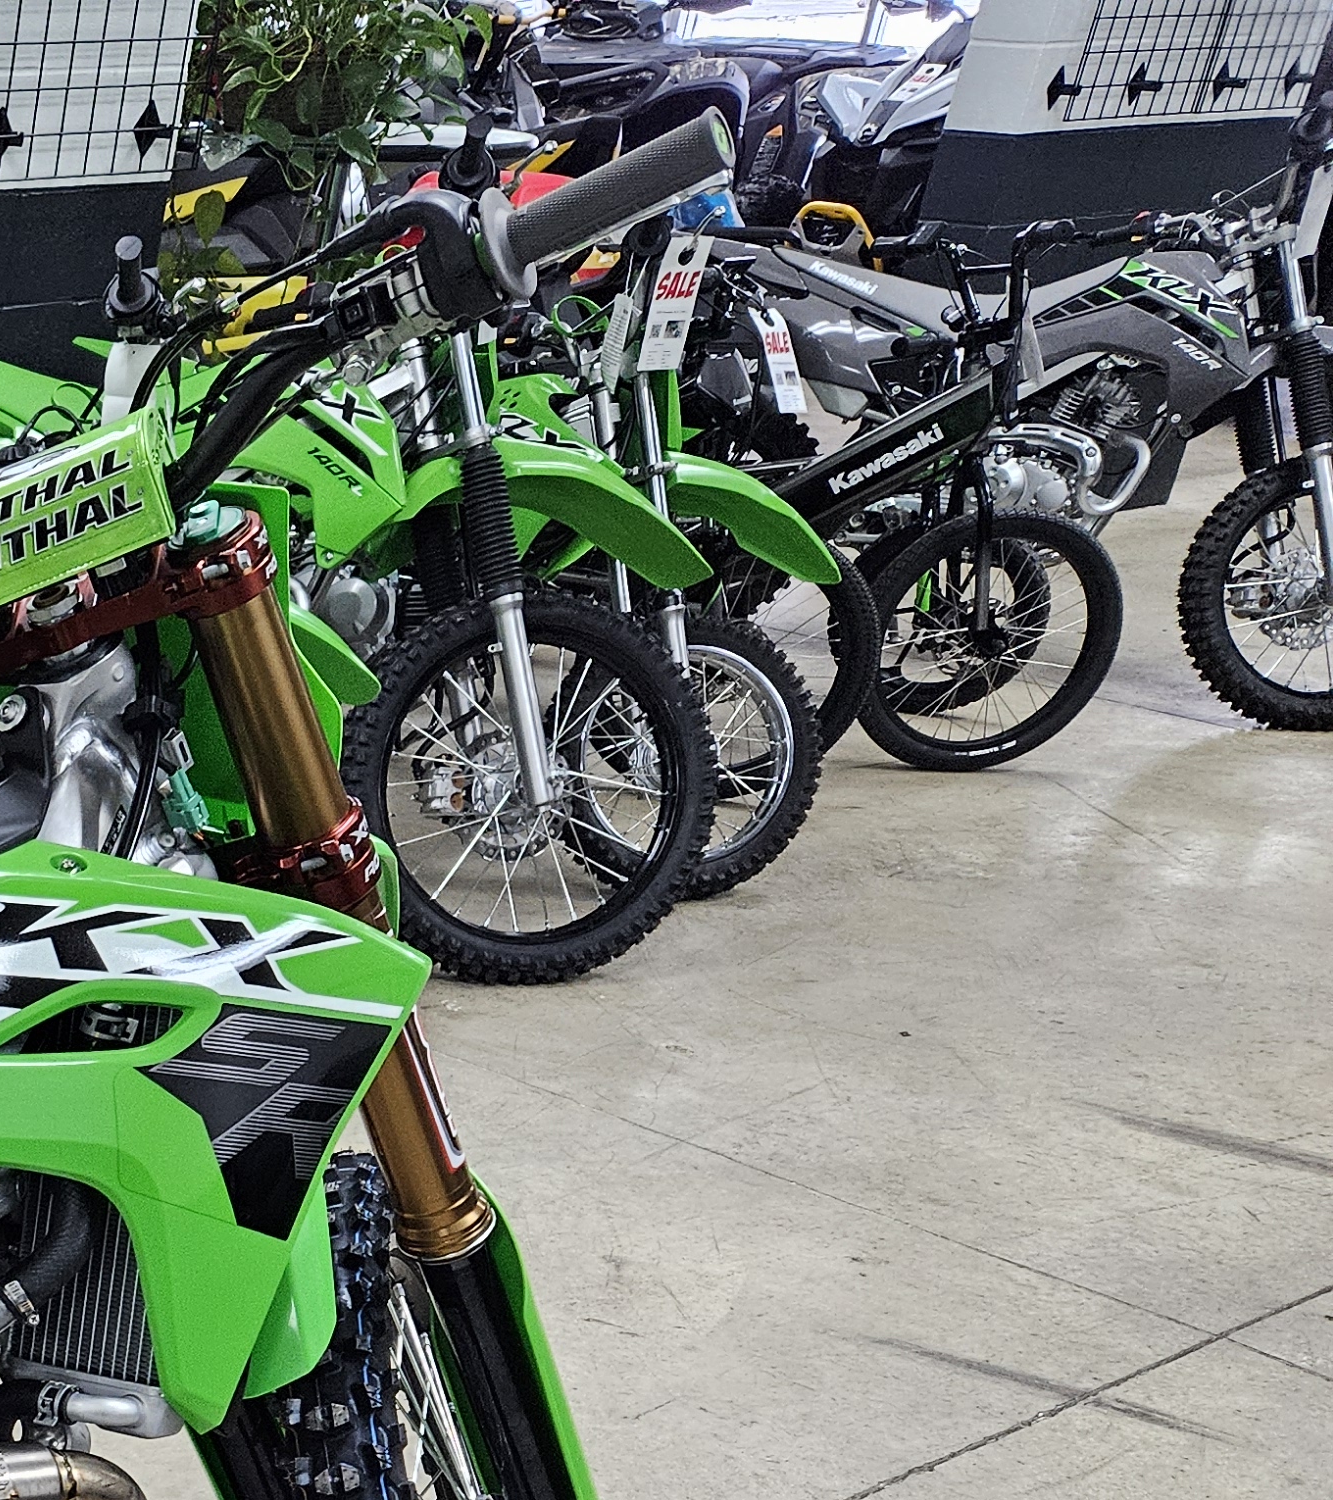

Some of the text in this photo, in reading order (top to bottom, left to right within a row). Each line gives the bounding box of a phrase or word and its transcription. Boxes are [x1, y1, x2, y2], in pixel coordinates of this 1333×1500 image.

[655, 270, 702, 300] SALE
[808, 260, 879, 296] Kawasaki
[764, 331, 791, 355] SALE
[1171, 337, 1223, 372] 140R
[306, 446, 363, 498] 140R
[827, 422, 945, 495] Kawasaki
